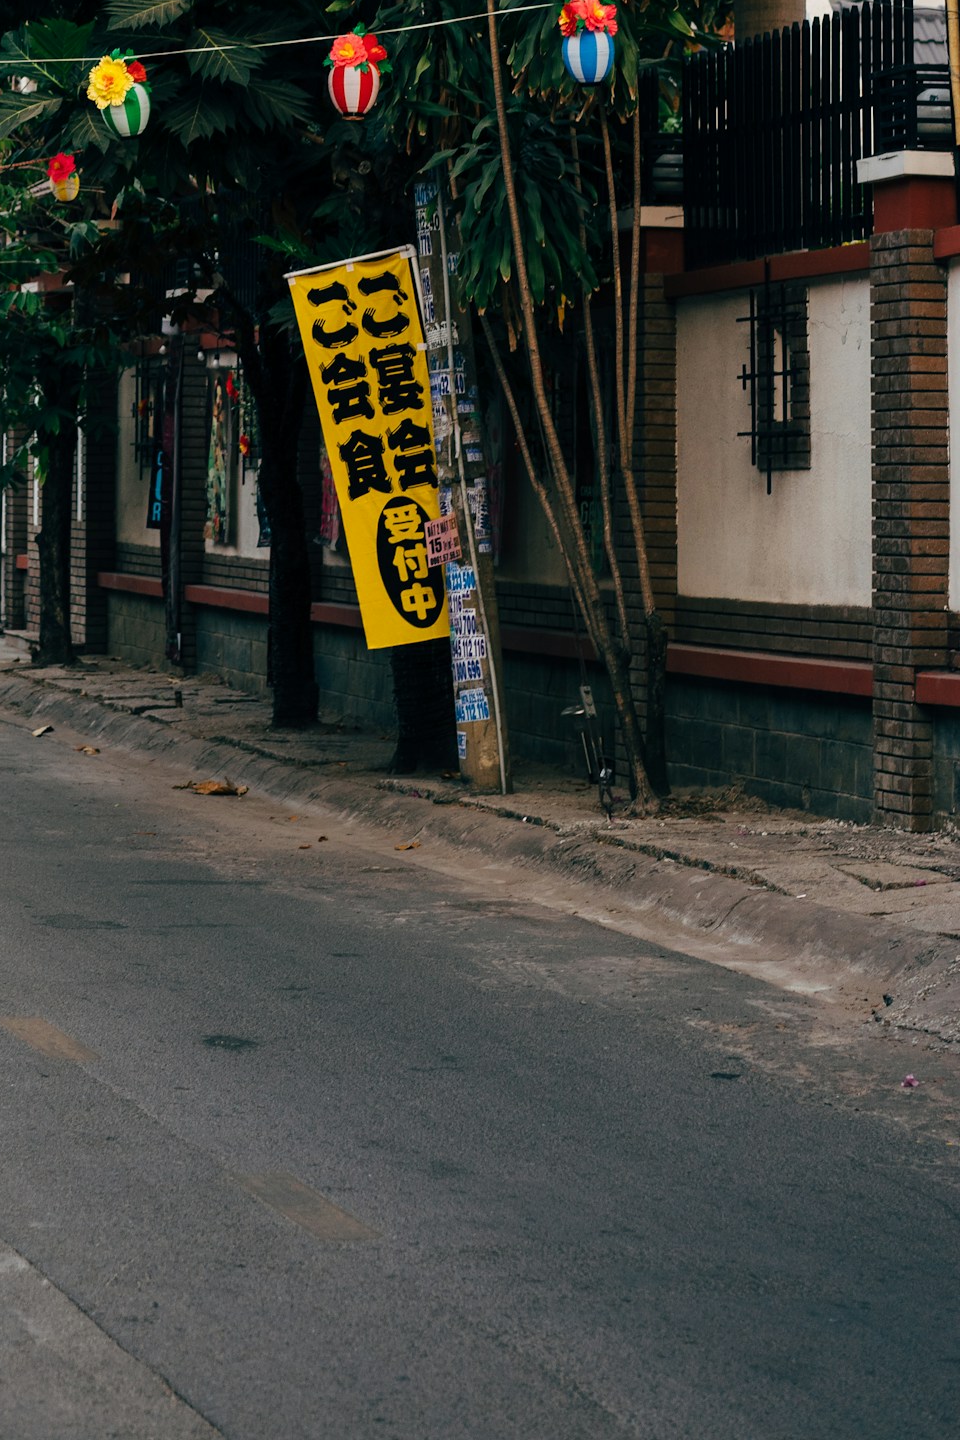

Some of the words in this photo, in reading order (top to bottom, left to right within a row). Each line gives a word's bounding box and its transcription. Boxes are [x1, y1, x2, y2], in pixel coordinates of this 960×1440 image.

[306, 281, 394, 502] ご会食
[357, 270, 438, 492] ご宴会
[382, 503, 437, 621] 受付中
[428, 537, 443, 554] 15
[462, 639, 473, 658] 112
[473, 638, 485, 658] 116
[465, 702, 476, 721] 112
[476, 701, 489, 720] 116
